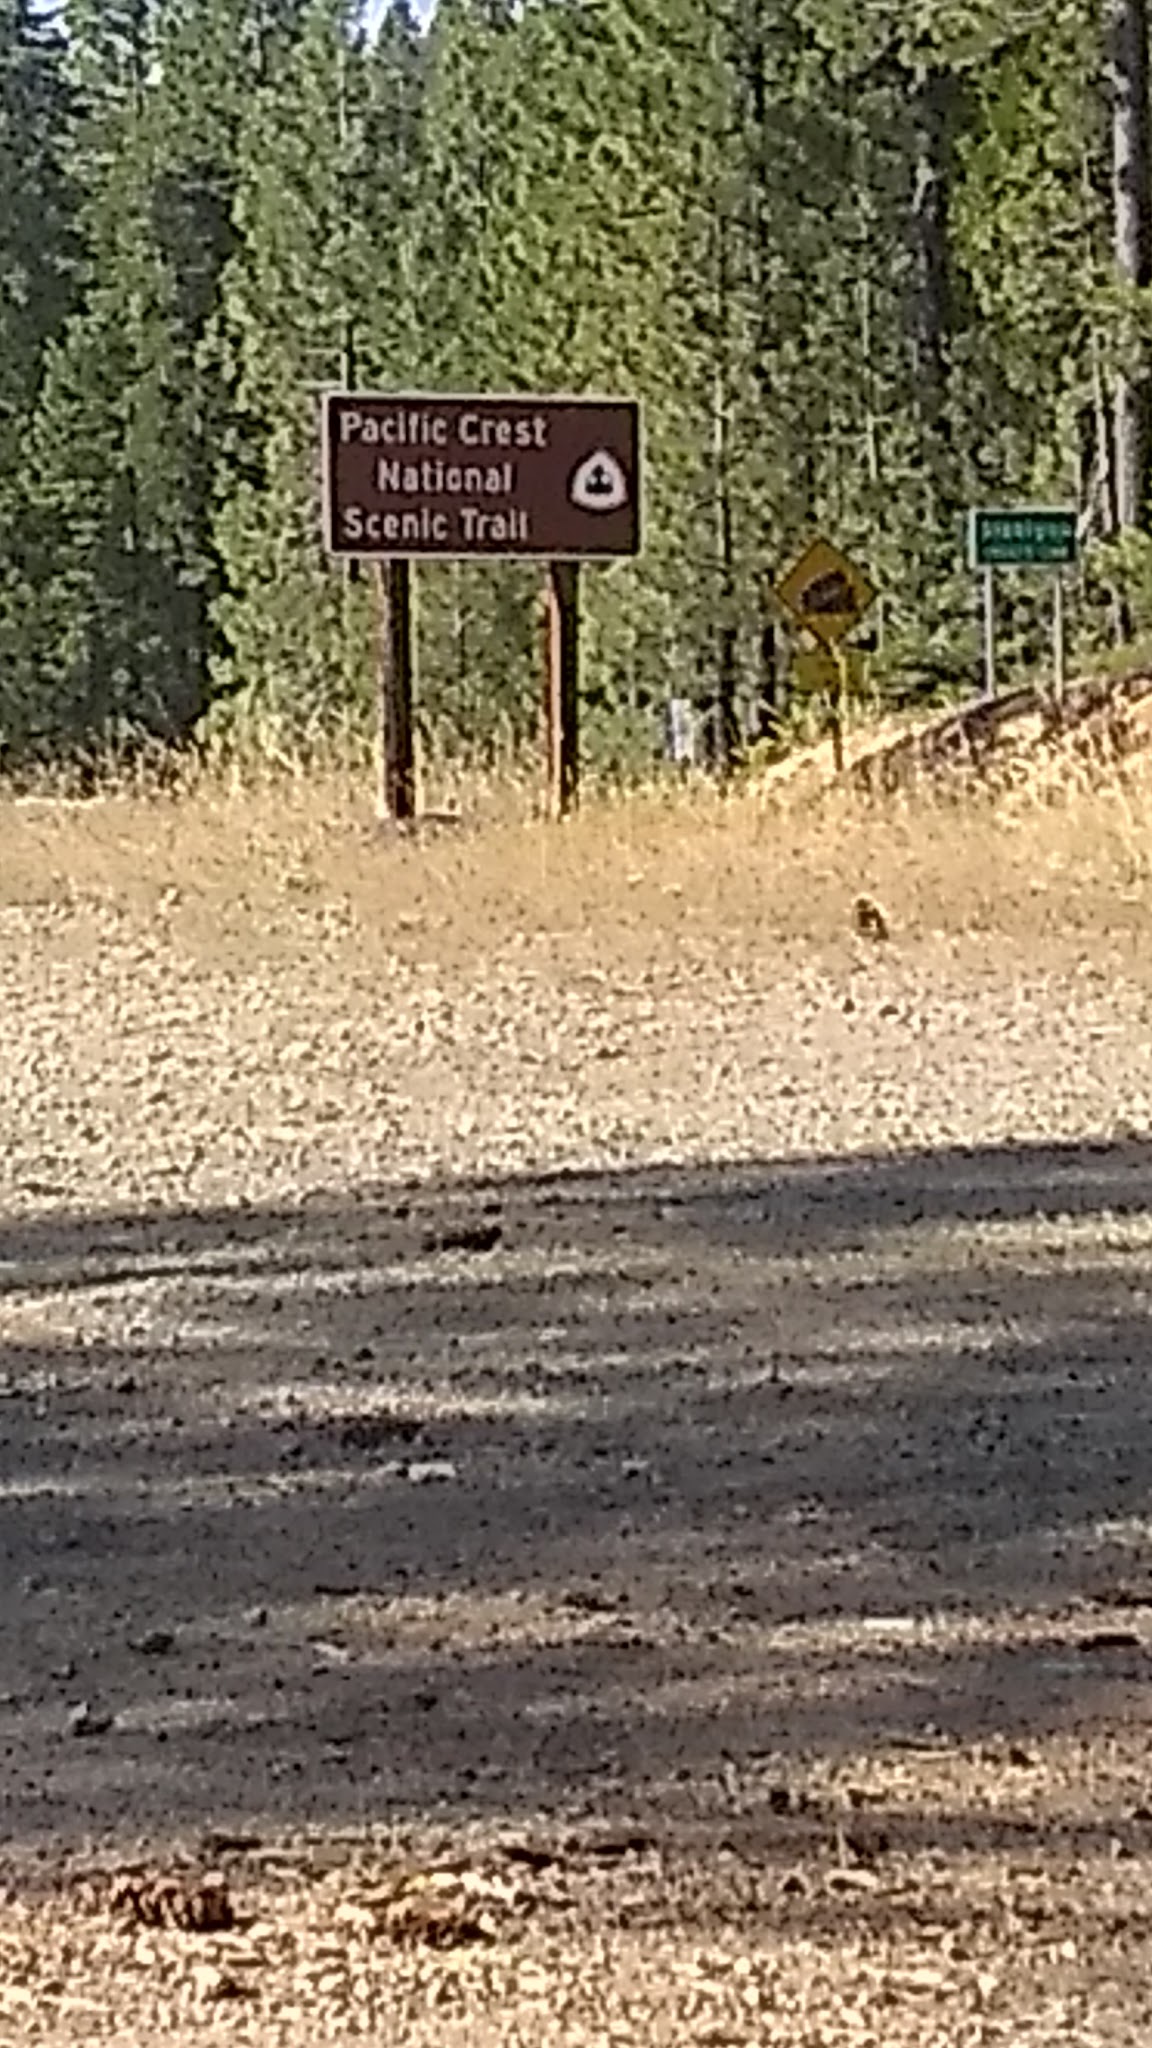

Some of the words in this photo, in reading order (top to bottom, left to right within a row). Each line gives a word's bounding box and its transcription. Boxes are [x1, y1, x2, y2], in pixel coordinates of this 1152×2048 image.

[339, 411, 448, 445] Pacific
[458, 414, 548, 448] Crest
[377, 458, 514, 493] National
[342, 507, 448, 541] Scenic
[461, 507, 530, 541] Trail
